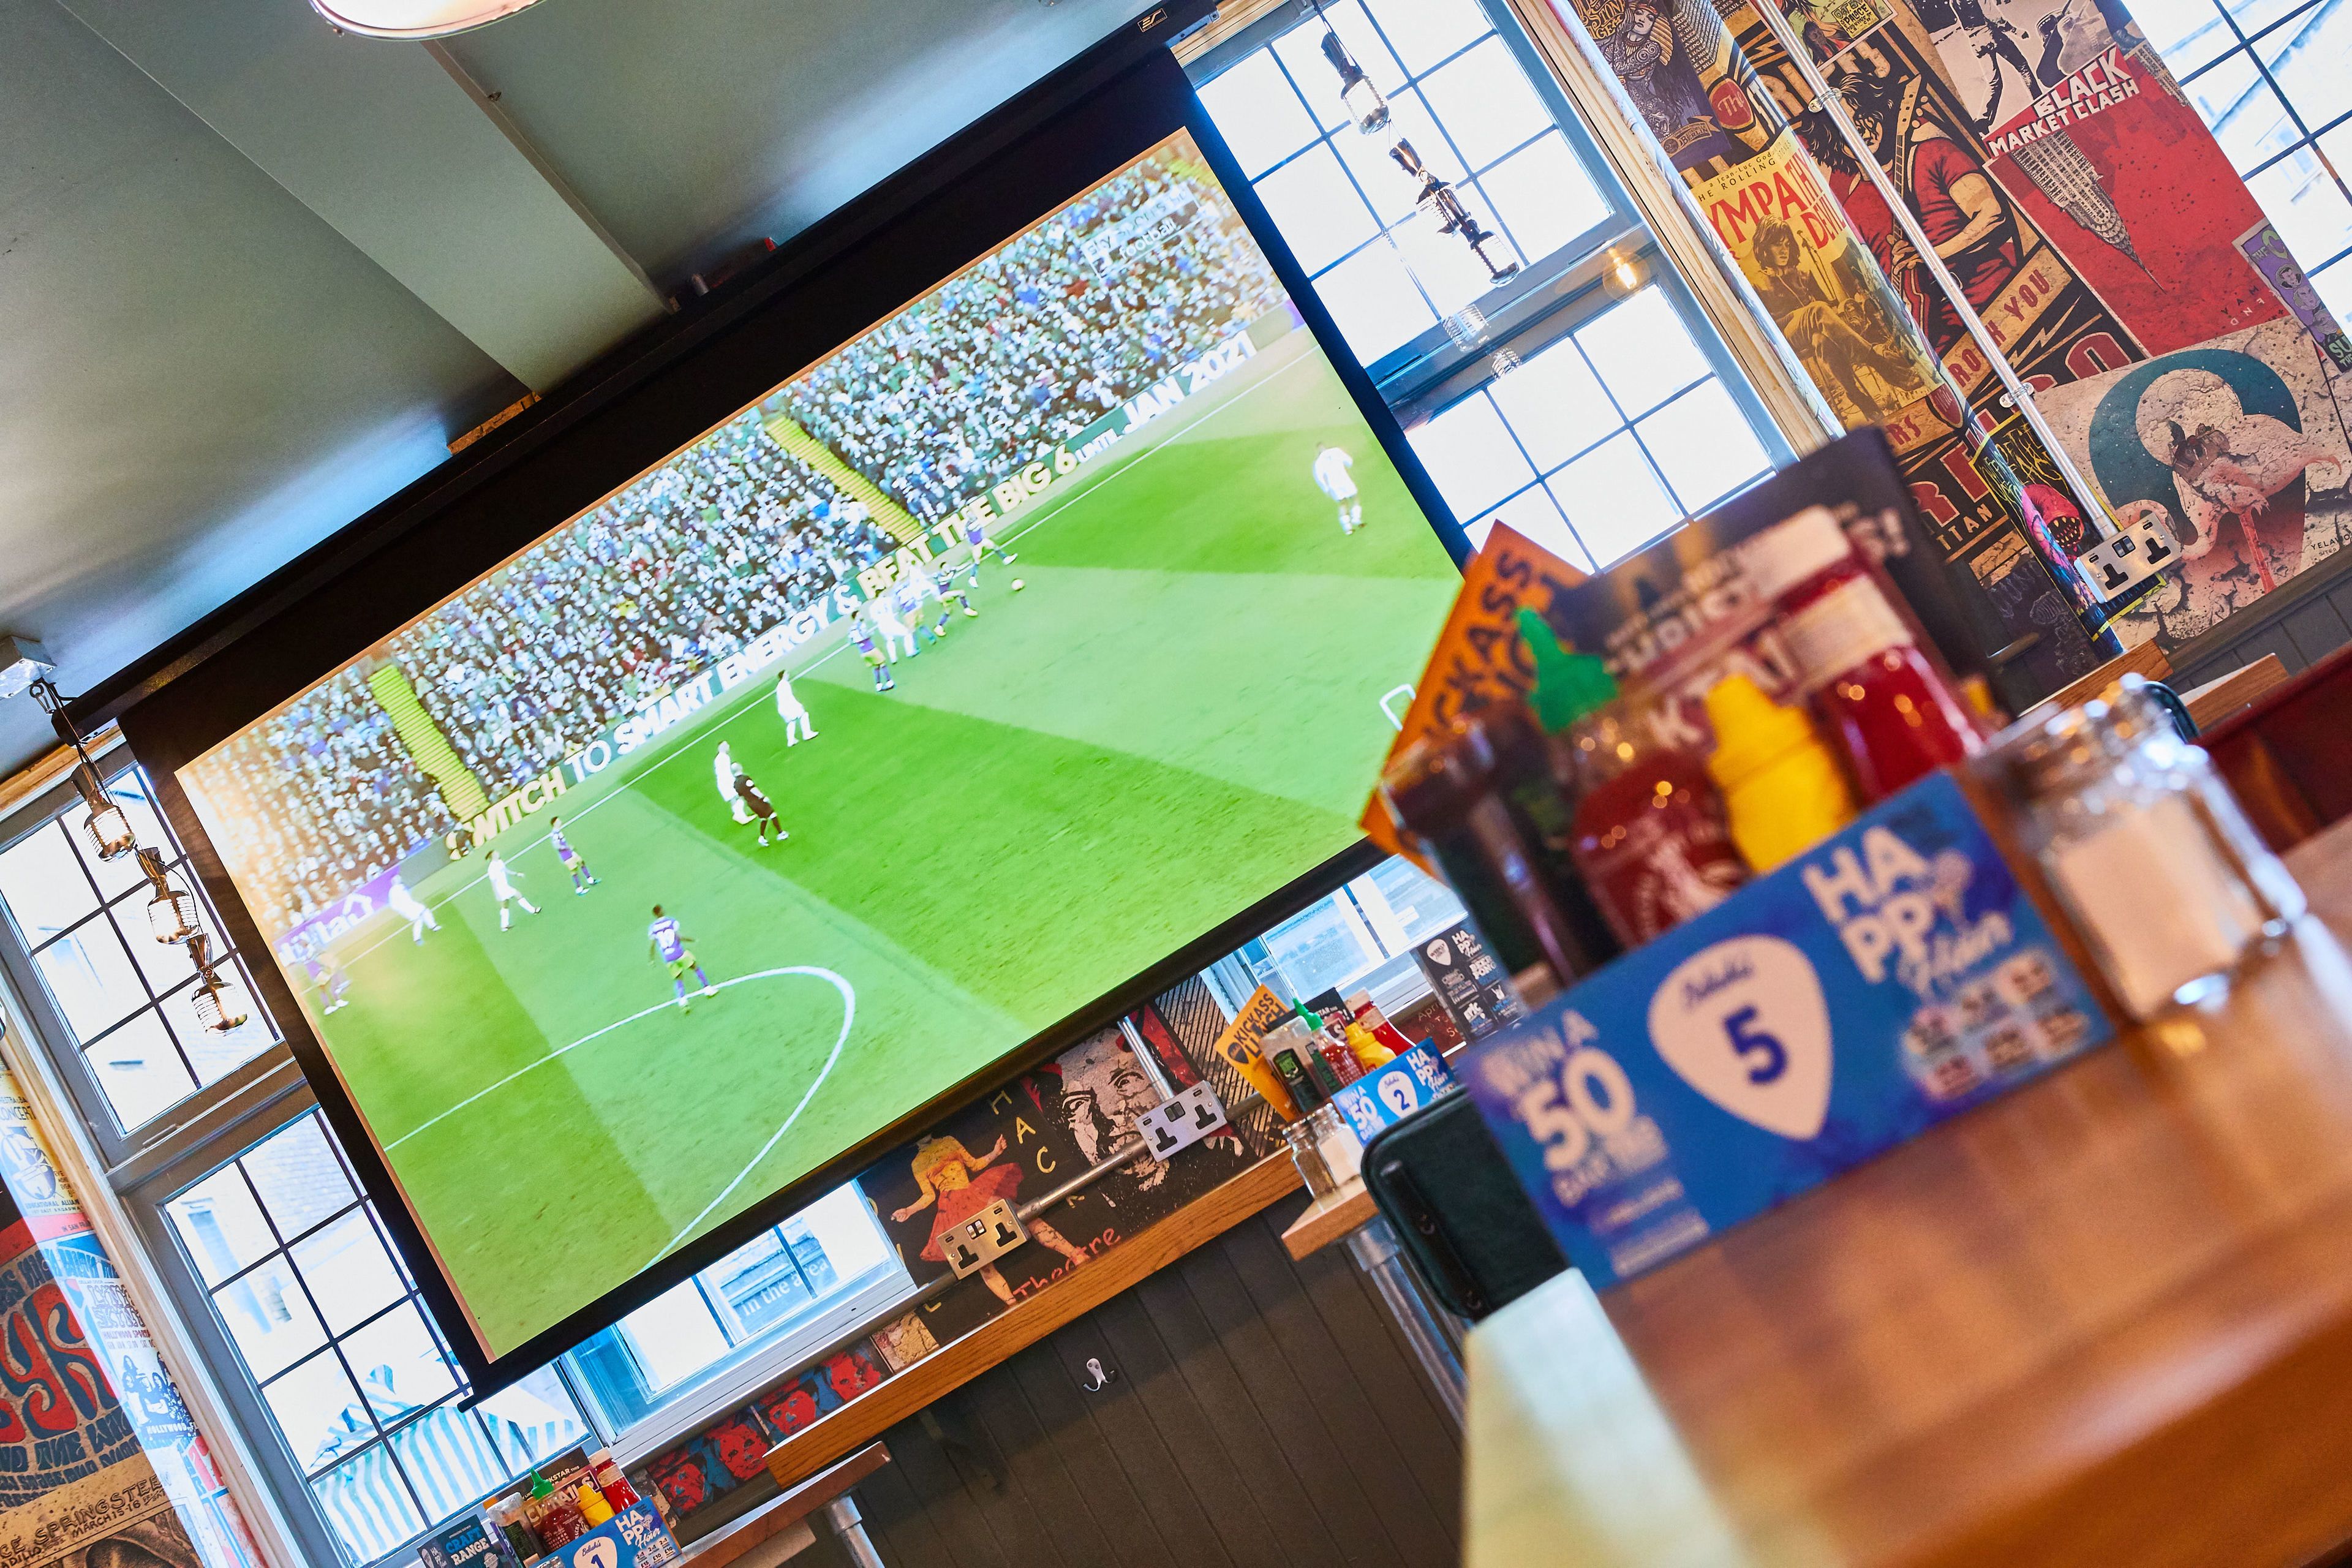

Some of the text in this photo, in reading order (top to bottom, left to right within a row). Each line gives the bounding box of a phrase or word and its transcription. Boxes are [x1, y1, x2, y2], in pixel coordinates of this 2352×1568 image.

[2032, 46, 2131, 118] BLACK
[1715, 88, 1747, 116] The
[1987, 78, 2140, 157] MARKET CLASH
[1716, 160, 1752, 185] Jean-Luc
[1721, 157, 1776, 190] ROLLING
[1801, 193, 1847, 250] DEVIL
[1117, 215, 1178, 262] football
[2002, 268, 2051, 322] YOU
[562, 736, 618, 785] TO
[605, 669, 726, 757] SMART
[712, 594, 832, 692] ENERGY
[827, 580, 864, 618] &
[929, 494, 1000, 552] THE
[989, 458, 1057, 514] BIG
[1047, 442, 1081, 478] 6
[1073, 424, 1123, 464] UNTIL
[1110, 374, 1188, 437] JAN
[1177, 329, 1259, 395] 2021
[1795, 810, 1934, 928] HA
[1451, 928, 1470, 945] HA
[1234, 991, 1275, 1044] KICKASS
[1405, 1047, 1431, 1071] HA
[1715, 998, 1797, 1093] 5
[1356, 1084, 1366, 1096] A
[1392, 1087, 1411, 1111] 2
[1011, 1226, 1121, 1298] Theatre
[740, 1255, 831, 1316] in the aea
[70, 1513, 111, 1539] MARCH
[110, 1499, 141, 1519] 15-16
[613, 1507, 645, 1533] HA
[443, 1525, 484, 1555] CRAFT
[450, 1537, 491, 1566] RANGE
[579, 1539, 604, 1558] Belushi's
[633, 1526, 664, 1550] Hour
[588, 1553, 604, 1567] 1
